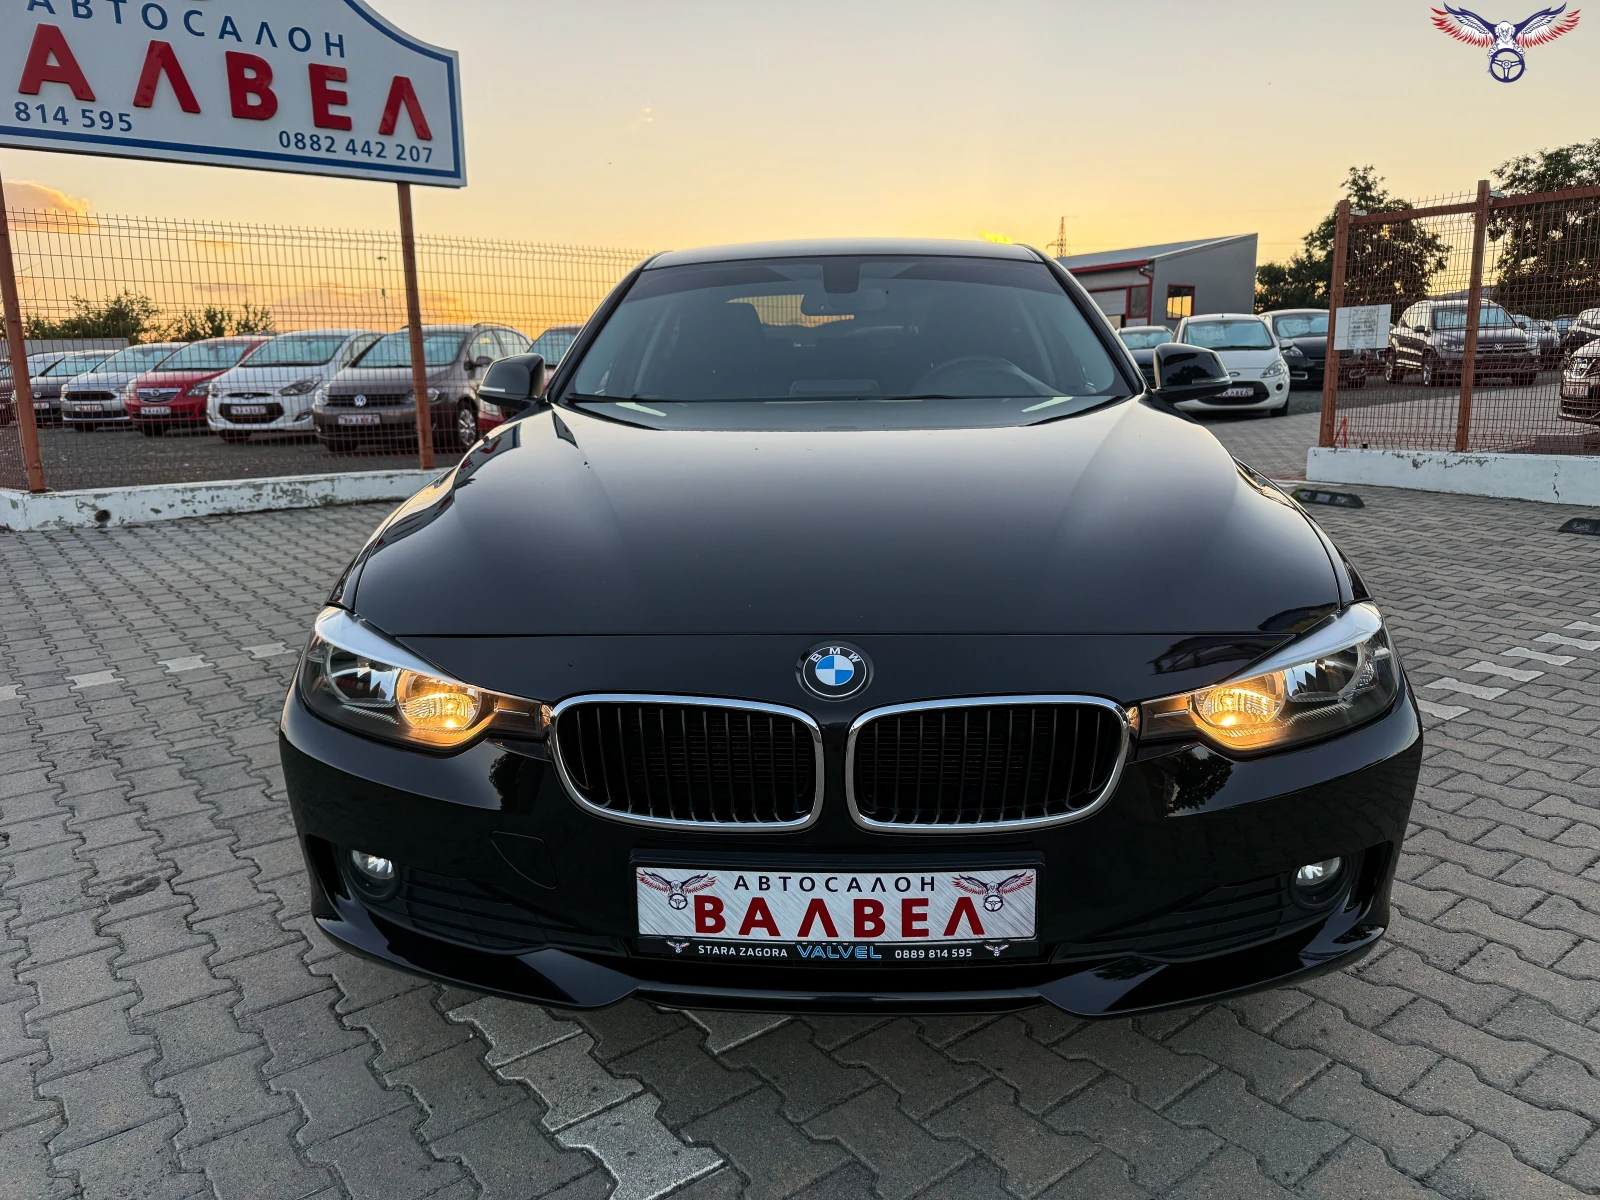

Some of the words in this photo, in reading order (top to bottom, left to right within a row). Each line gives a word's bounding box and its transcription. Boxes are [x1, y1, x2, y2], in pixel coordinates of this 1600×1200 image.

[14, 101, 69, 126] 814
[81, 108, 133, 132] 595
[278, 130, 337, 153] 0882
[345, 138, 387, 159] 442
[395, 144, 433, 163] 207
[809, 647, 861, 663] BMW
[733, 875, 936, 893] АВТОСАЛОН
[693, 895, 985, 938] ВАЛВЕЛ
[698, 945, 736, 956] STARA
[739, 947, 788, 957] ZAGORA
[796, 945, 882, 959] VALVEL
[895, 950, 925, 959] 0889
[928, 949, 949, 958] 814
[951, 949, 973, 958] 595
